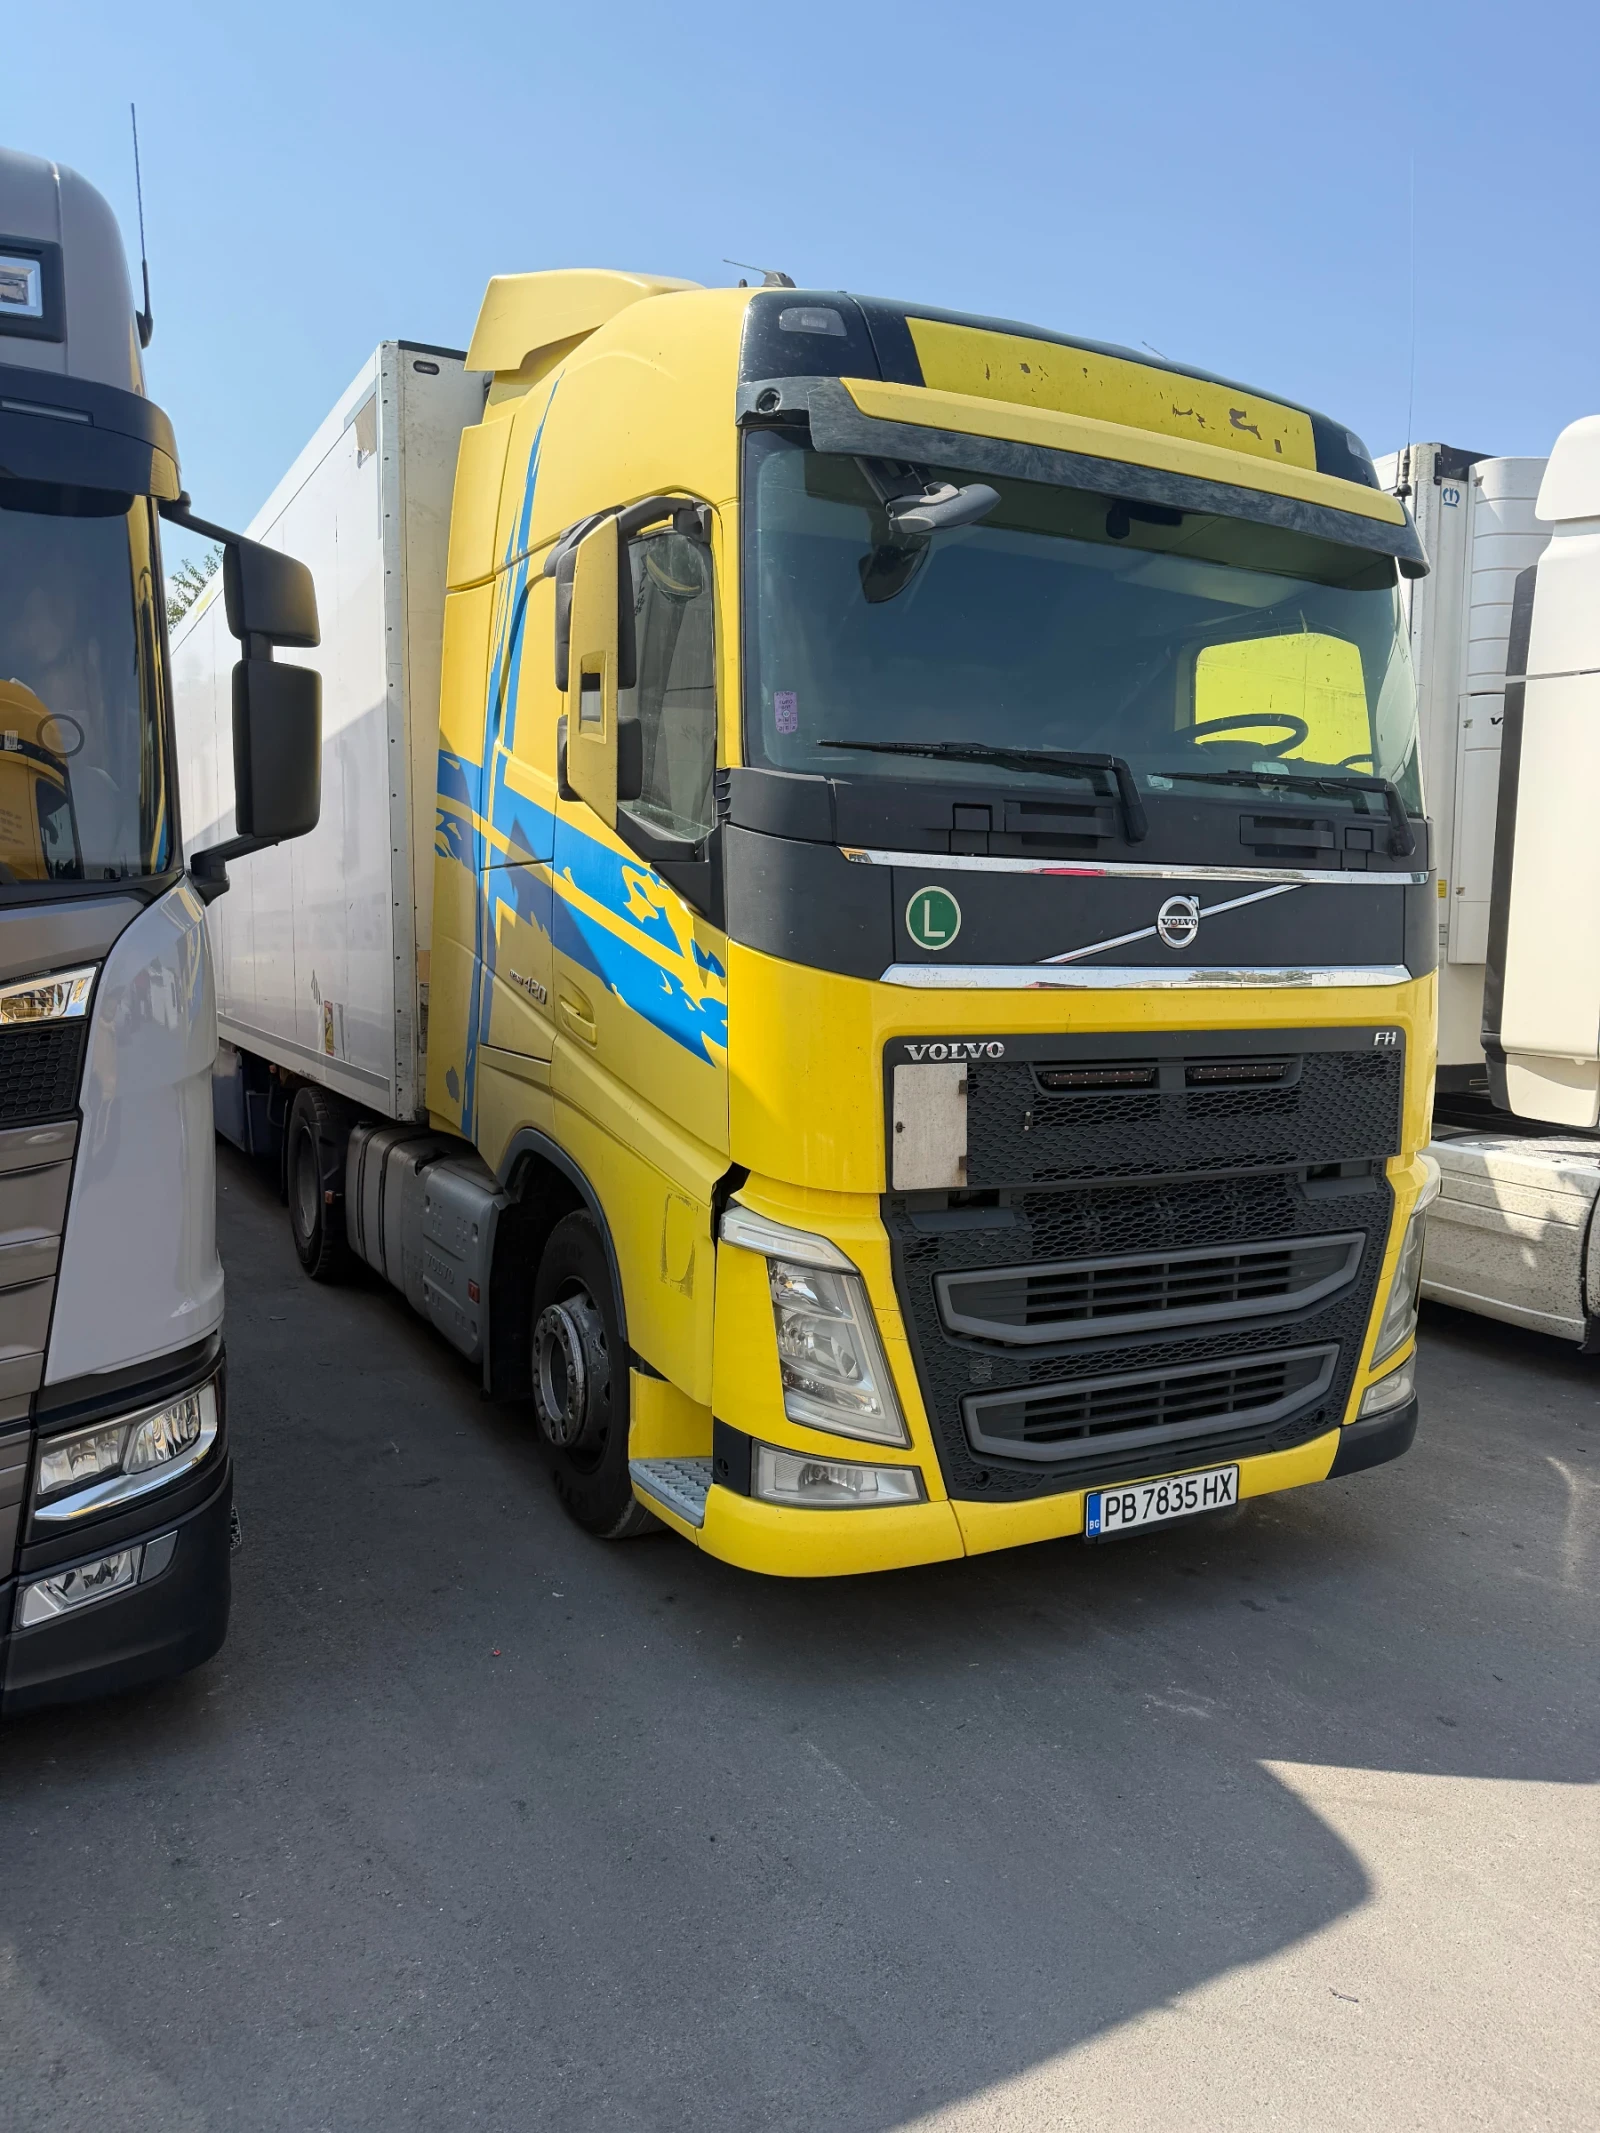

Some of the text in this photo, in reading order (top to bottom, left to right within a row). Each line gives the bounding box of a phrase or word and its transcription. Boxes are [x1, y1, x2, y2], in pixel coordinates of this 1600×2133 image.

[924, 900, 946, 937] L
[1161, 918, 1197, 926] VOLVO
[1373, 1031, 1397, 1046] FH
[904, 1041, 1005, 1061] VOLVO
[1105, 1472, 1233, 1527] PB 7835 HX
[1089, 1519, 1100, 1530] BG
